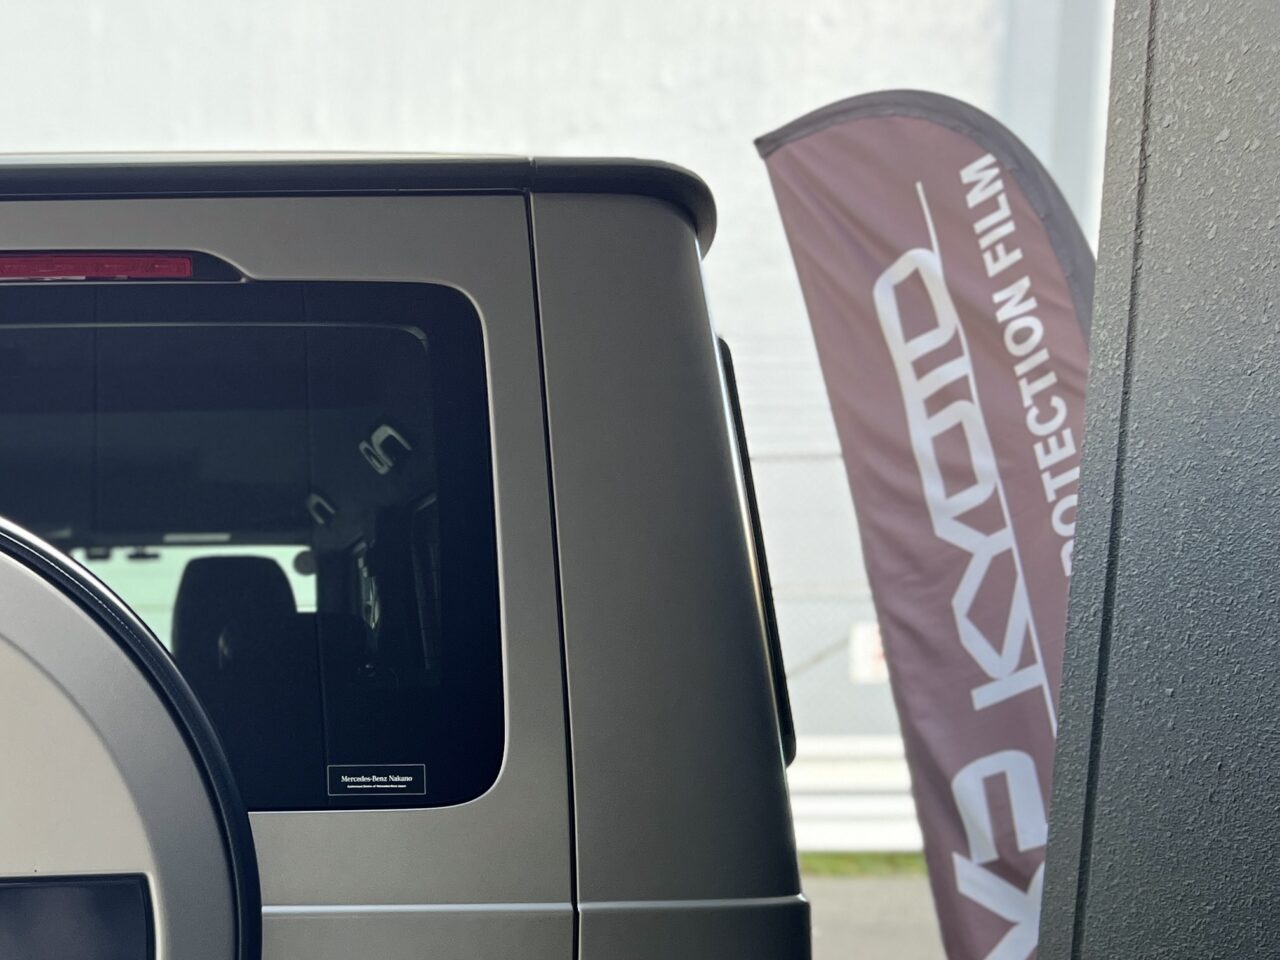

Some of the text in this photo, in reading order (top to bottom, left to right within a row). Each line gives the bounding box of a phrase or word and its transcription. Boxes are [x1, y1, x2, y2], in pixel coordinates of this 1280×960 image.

[873, 247, 1048, 710] KYOTO
[959, 153, 1080, 577] OTECTION FILM
[340, 774, 413, 783] Mercedes-Benz Nakano
